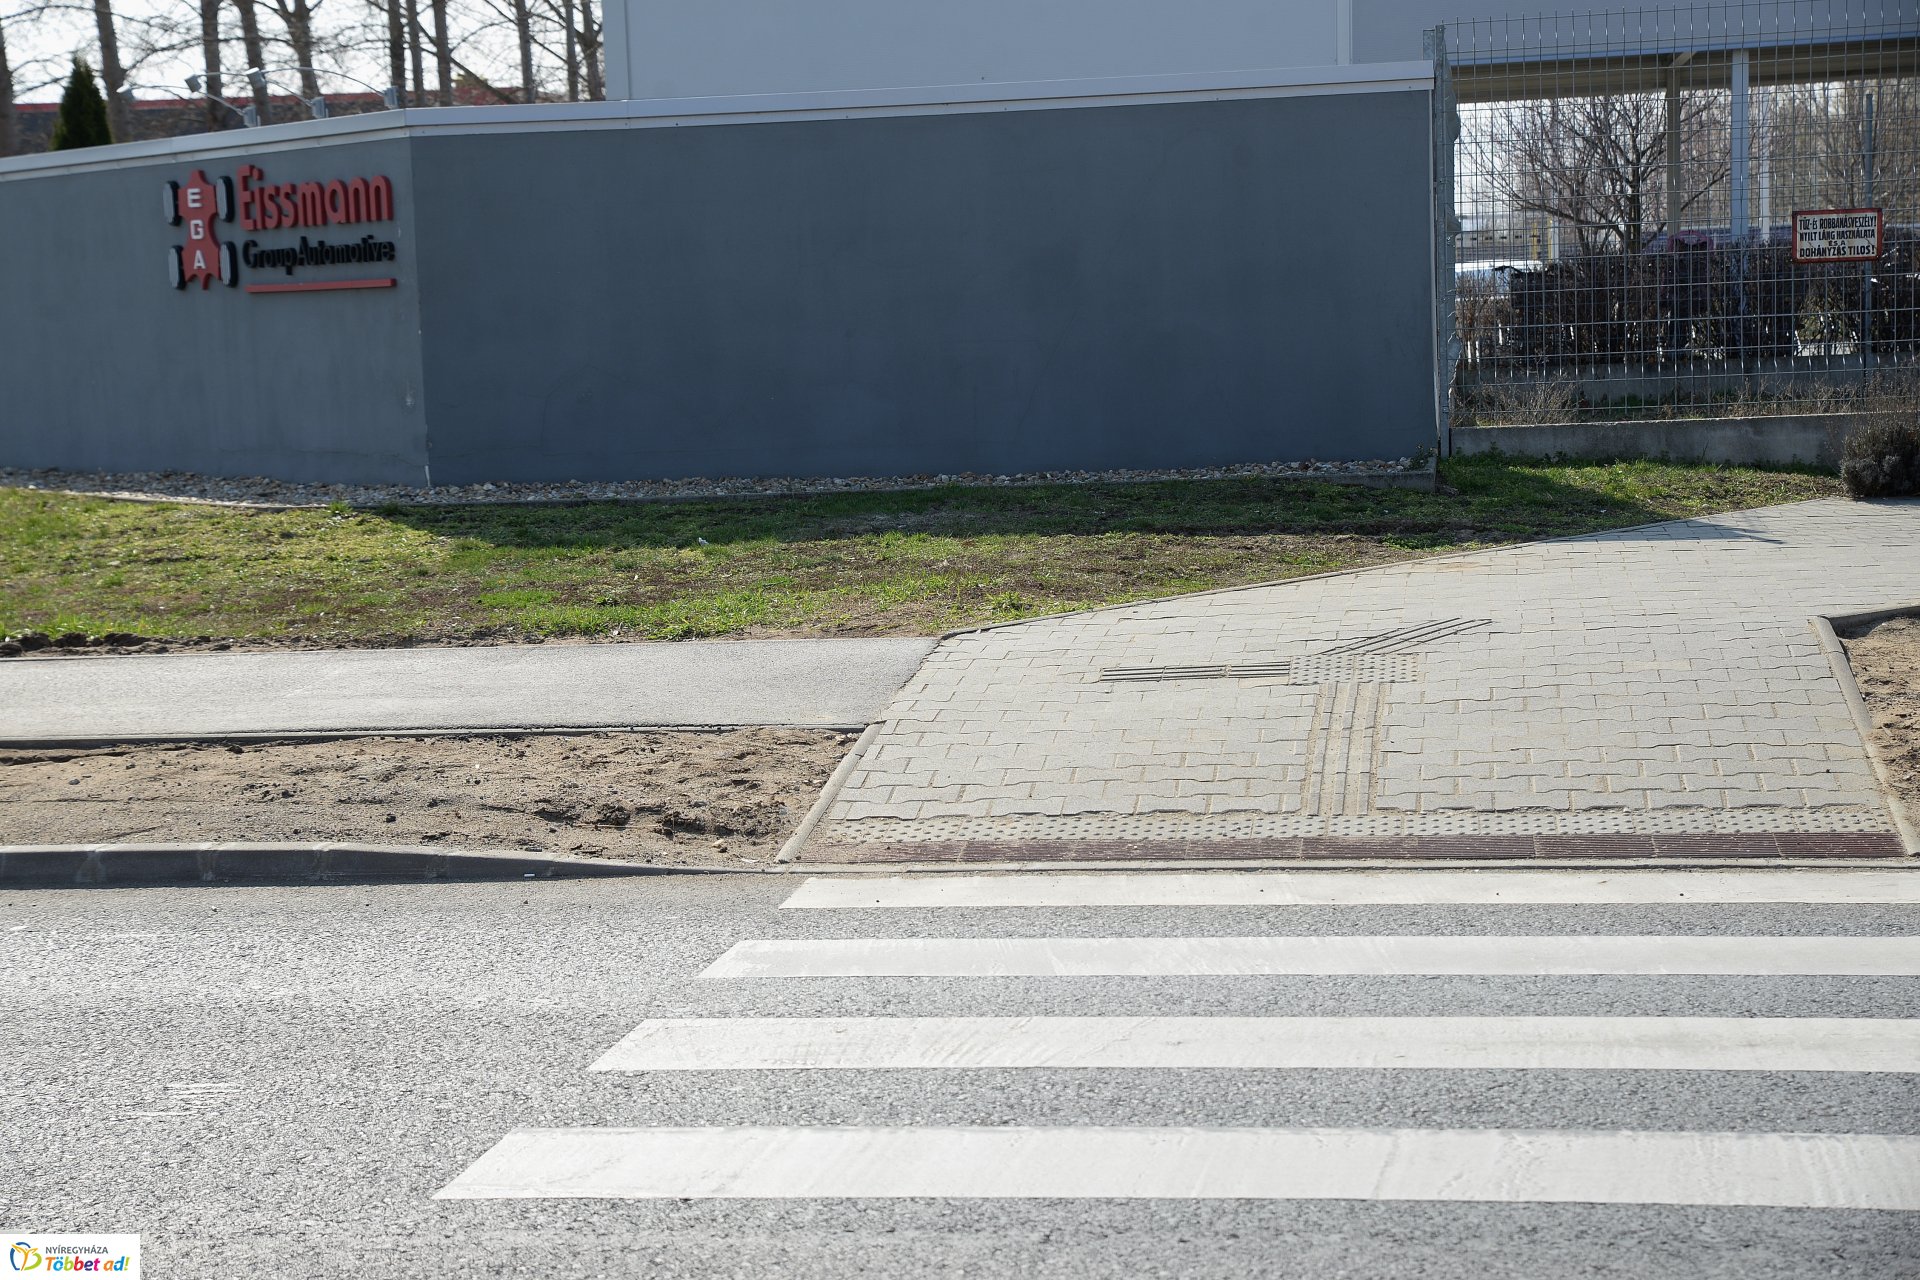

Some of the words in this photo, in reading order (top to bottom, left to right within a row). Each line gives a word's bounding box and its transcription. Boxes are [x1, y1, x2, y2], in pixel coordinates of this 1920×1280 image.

[237, 164, 394, 231] Eissmann
[1820, 215, 1877, 229] ROBBANÁSVESZÉLY!
[1799, 231, 1818, 241] NYILT
[1818, 229, 1836, 240] LÁNG
[1836, 228, 1875, 239] HASZNÁLATA
[242, 240, 298, 276] Group
[298, 234, 396, 268] Automotive
[1799, 245, 1847, 257] DOHÁNYZÁS
[1848, 245, 1876, 256] TILOS!
